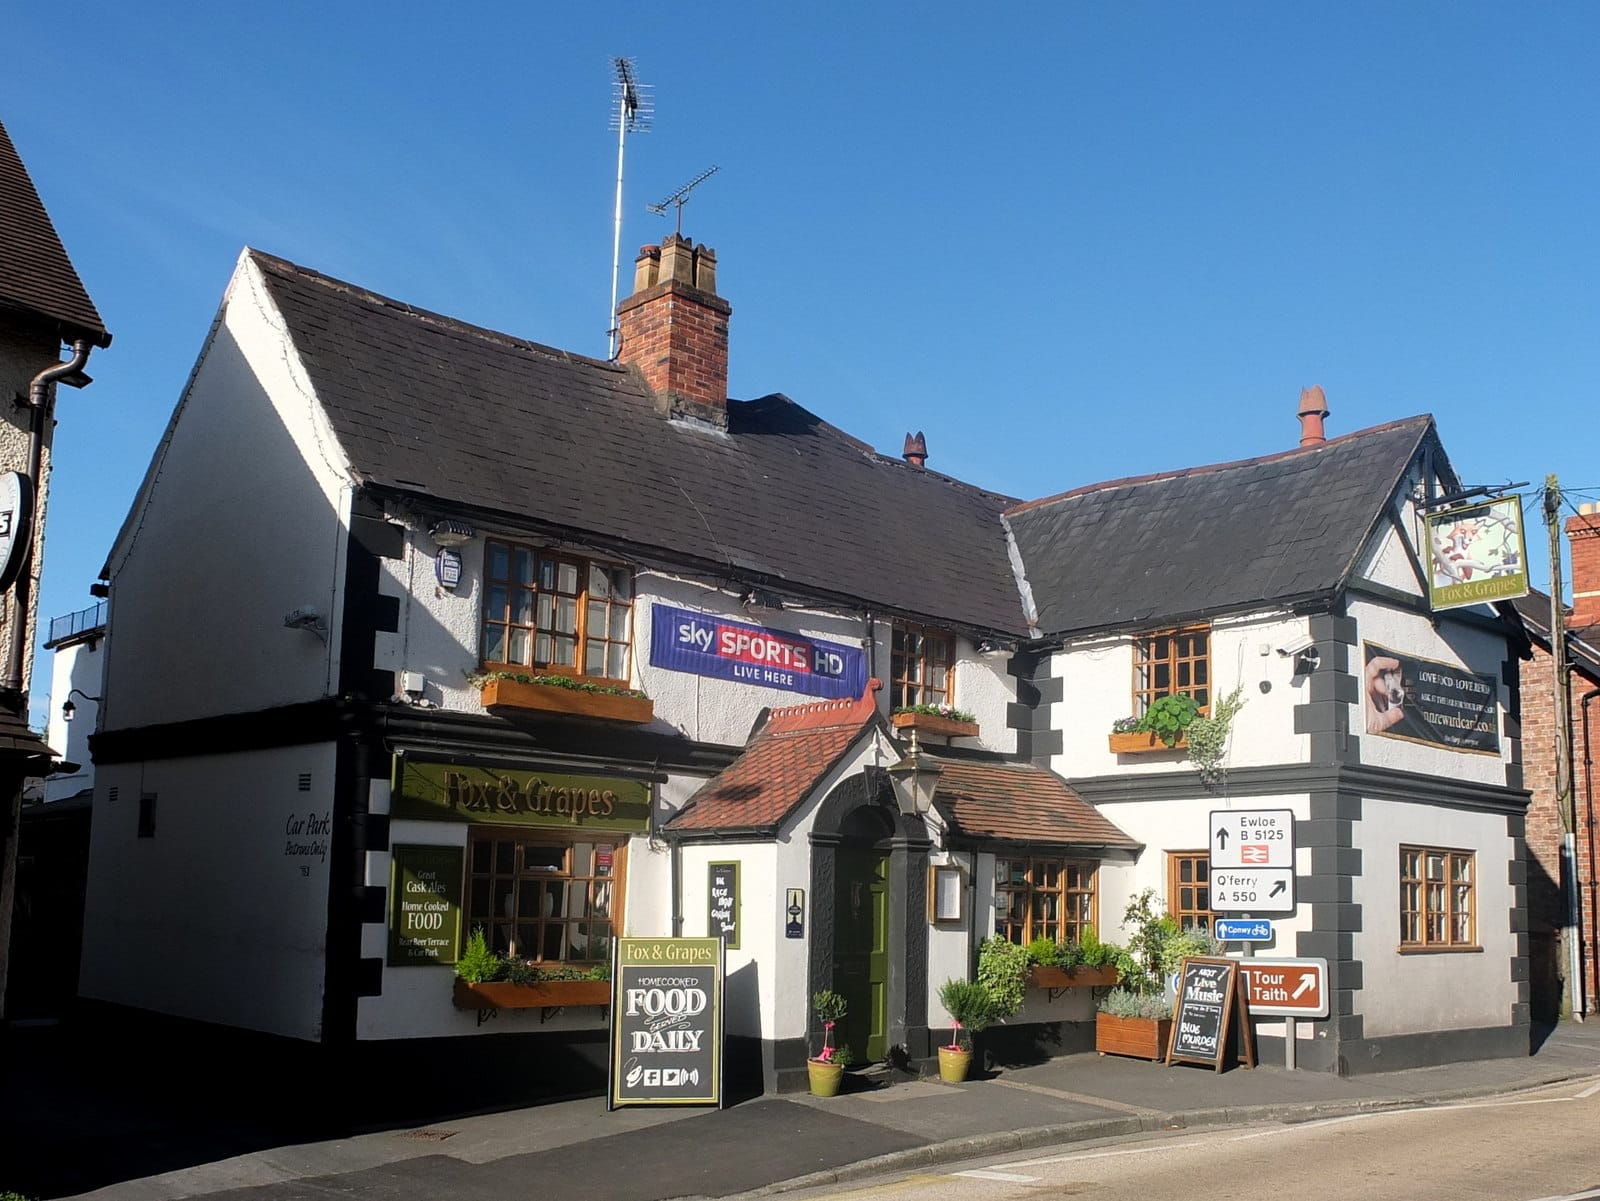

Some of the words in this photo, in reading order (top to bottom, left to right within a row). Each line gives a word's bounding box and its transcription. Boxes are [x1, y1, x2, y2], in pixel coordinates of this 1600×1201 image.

[1441, 588, 1461, 601] Fox
[1463, 584, 1473, 598] &
[1475, 578, 1517, 596] Grapes
[679, 621, 714, 652] sky
[721, 631, 807, 668] SPORTS
[814, 650, 844, 675] HD
[733, 665, 760, 680] LIVE
[764, 670, 793, 686] HERE
[1419, 671, 1437, 684] LOVE
[443, 771, 491, 808] Fox
[496, 775, 517, 810] &
[525, 776, 615, 823] Grapes
[286, 813, 305, 835] Car
[305, 811, 330, 835] Park
[1240, 816, 1275, 827] Ewloe
[1240, 831, 1249, 841] B
[1255, 830, 1284, 841] 5125
[406, 881, 427, 893] Cask
[428, 881, 447, 893] Ales
[1218, 892, 1226, 902] A
[1232, 891, 1257, 902] 550
[402, 901, 422, 912] Home
[424, 901, 449, 912] Cooked
[408, 912, 443, 930] FOOD
[413, 938, 427, 946] Beer
[427, 938, 449, 946] Terrace
[425, 948, 439, 957] Park
[627, 944, 650, 960] Fox
[652, 944, 662, 960] &
[666, 944, 712, 963] Grapes
[638, 976, 699, 987] HOMECOOKED
[1194, 977, 1217, 989] Live
[1253, 970, 1285, 985] Tour
[1185, 986, 1224, 1003] Music
[1253, 987, 1288, 1001] Taith
[626, 988, 707, 1017] FOOD
[630, 1029, 704, 1053] DAILY
[1182, 1033, 1217, 1049] MURDER
